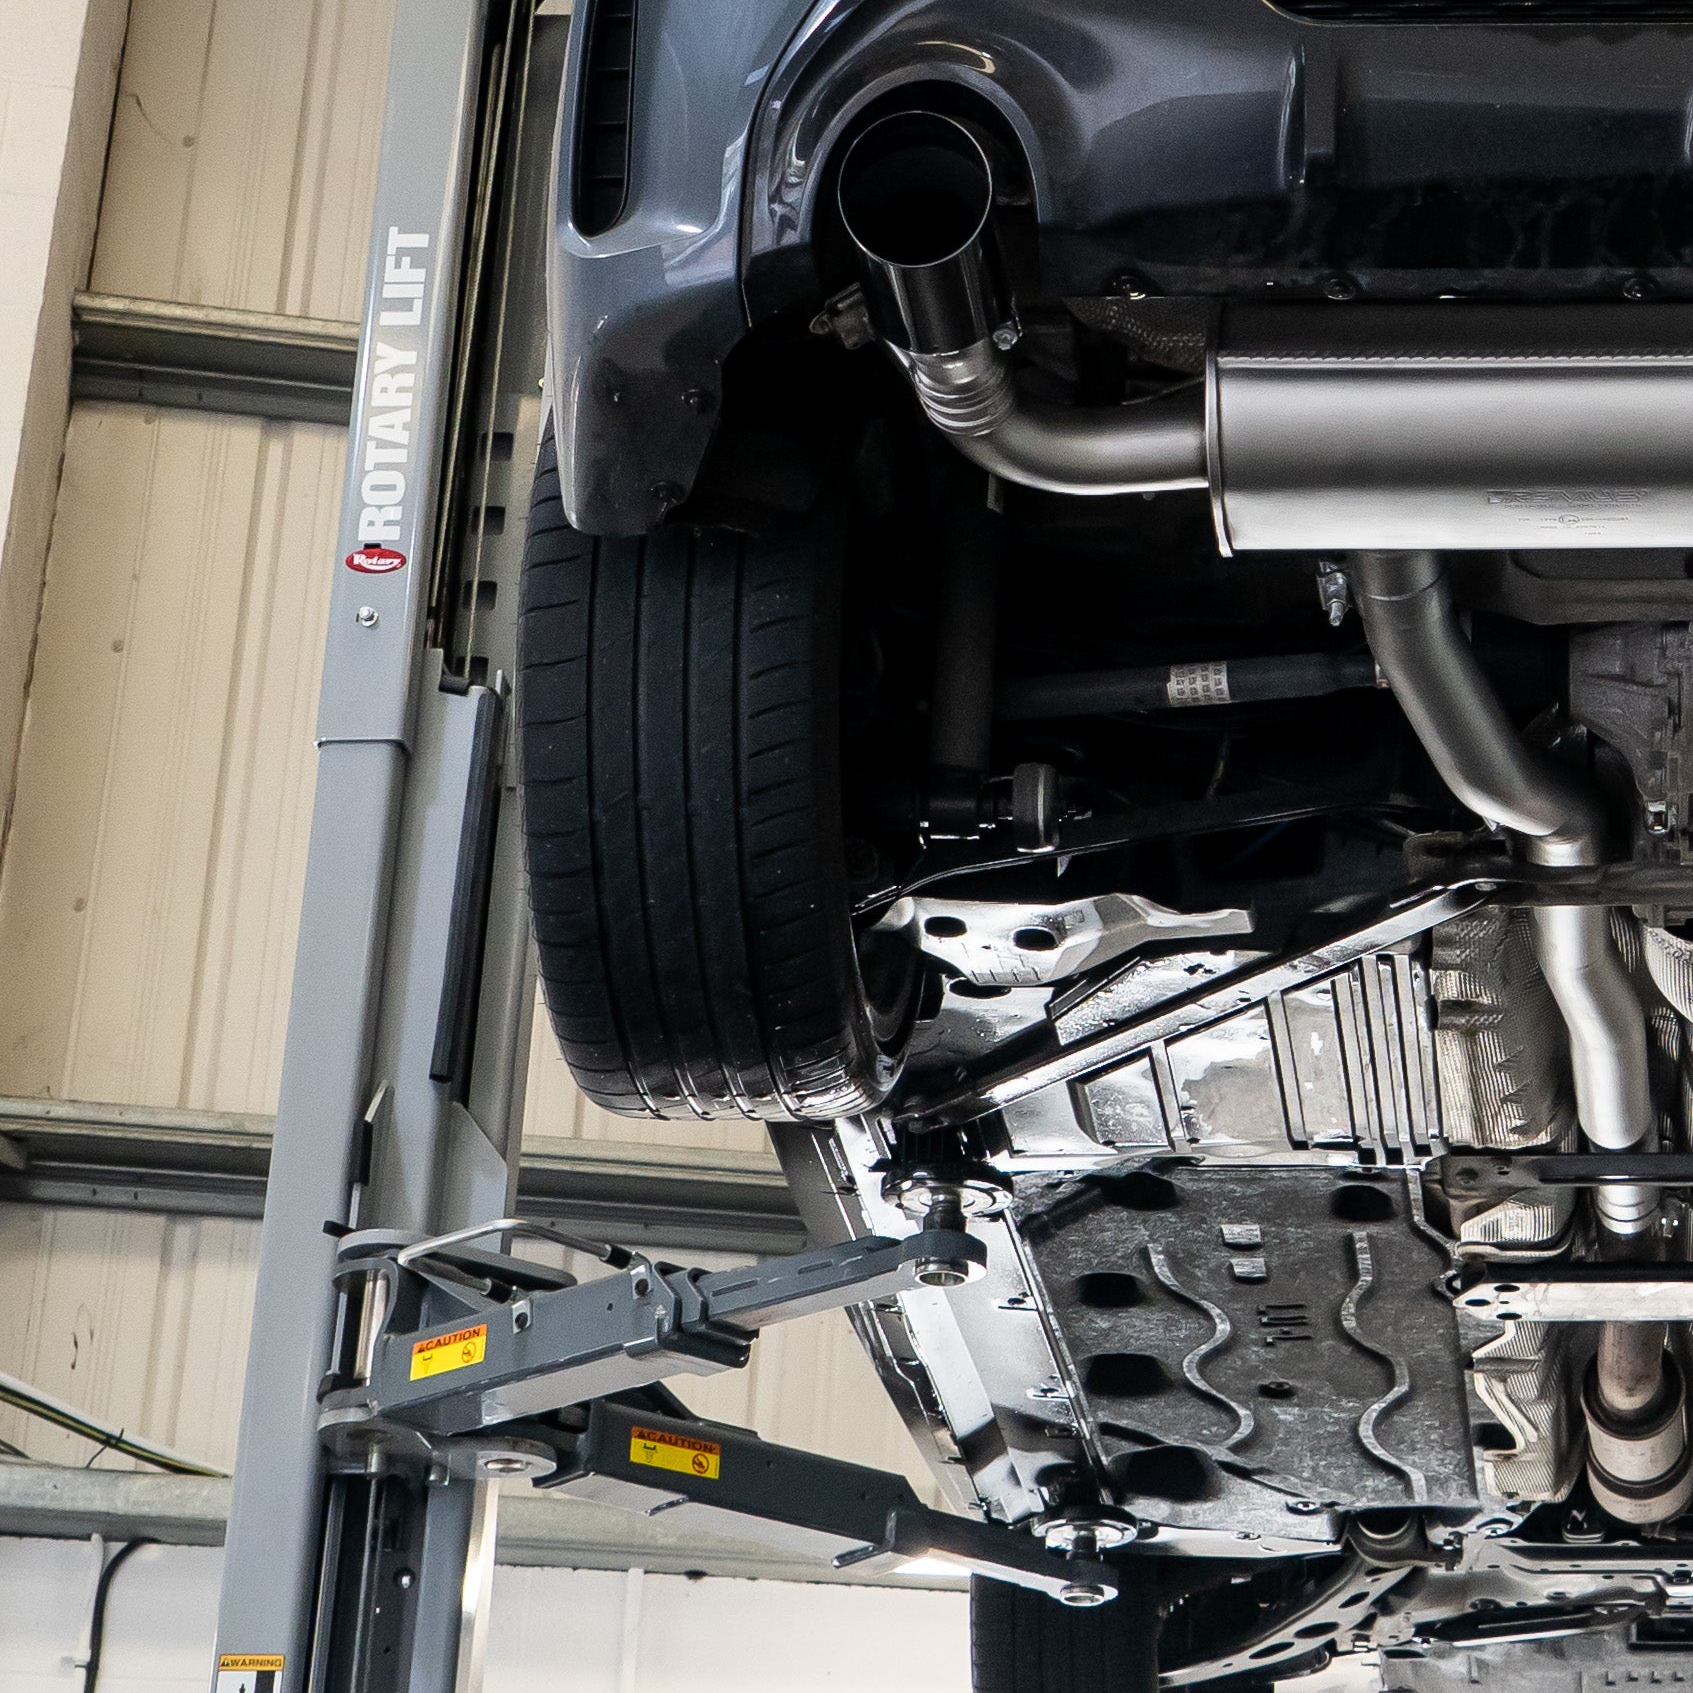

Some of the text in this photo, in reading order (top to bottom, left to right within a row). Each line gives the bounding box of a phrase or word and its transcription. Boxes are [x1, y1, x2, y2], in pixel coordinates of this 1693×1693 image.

[358, 227, 430, 541] ROTARY LIFT
[352, 553, 402, 571] Rotary
[425, 1327, 481, 1351] CAUTION
[648, 1430, 716, 1454] CAUTION
[230, 1658, 282, 1667] WARNING
